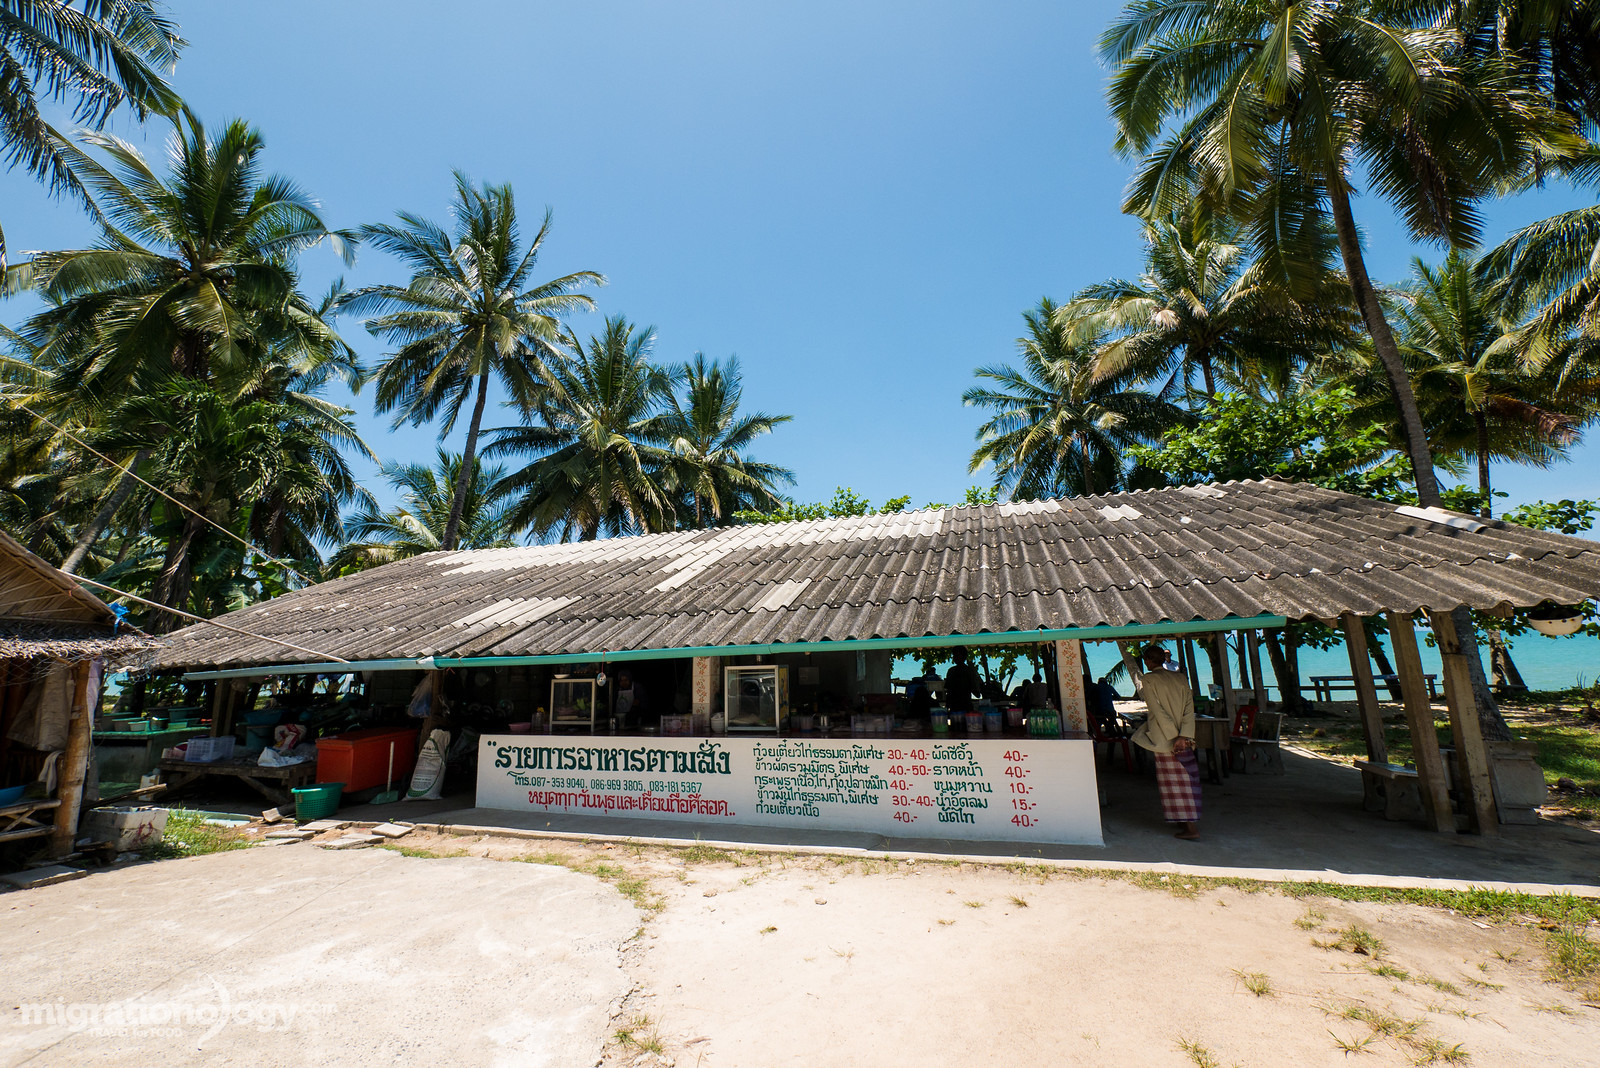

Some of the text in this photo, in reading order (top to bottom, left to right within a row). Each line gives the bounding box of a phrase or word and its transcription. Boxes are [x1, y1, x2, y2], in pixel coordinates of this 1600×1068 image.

[933, 760, 984, 777] ราดหน้า
[933, 780, 993, 793] ขนมหวาน
